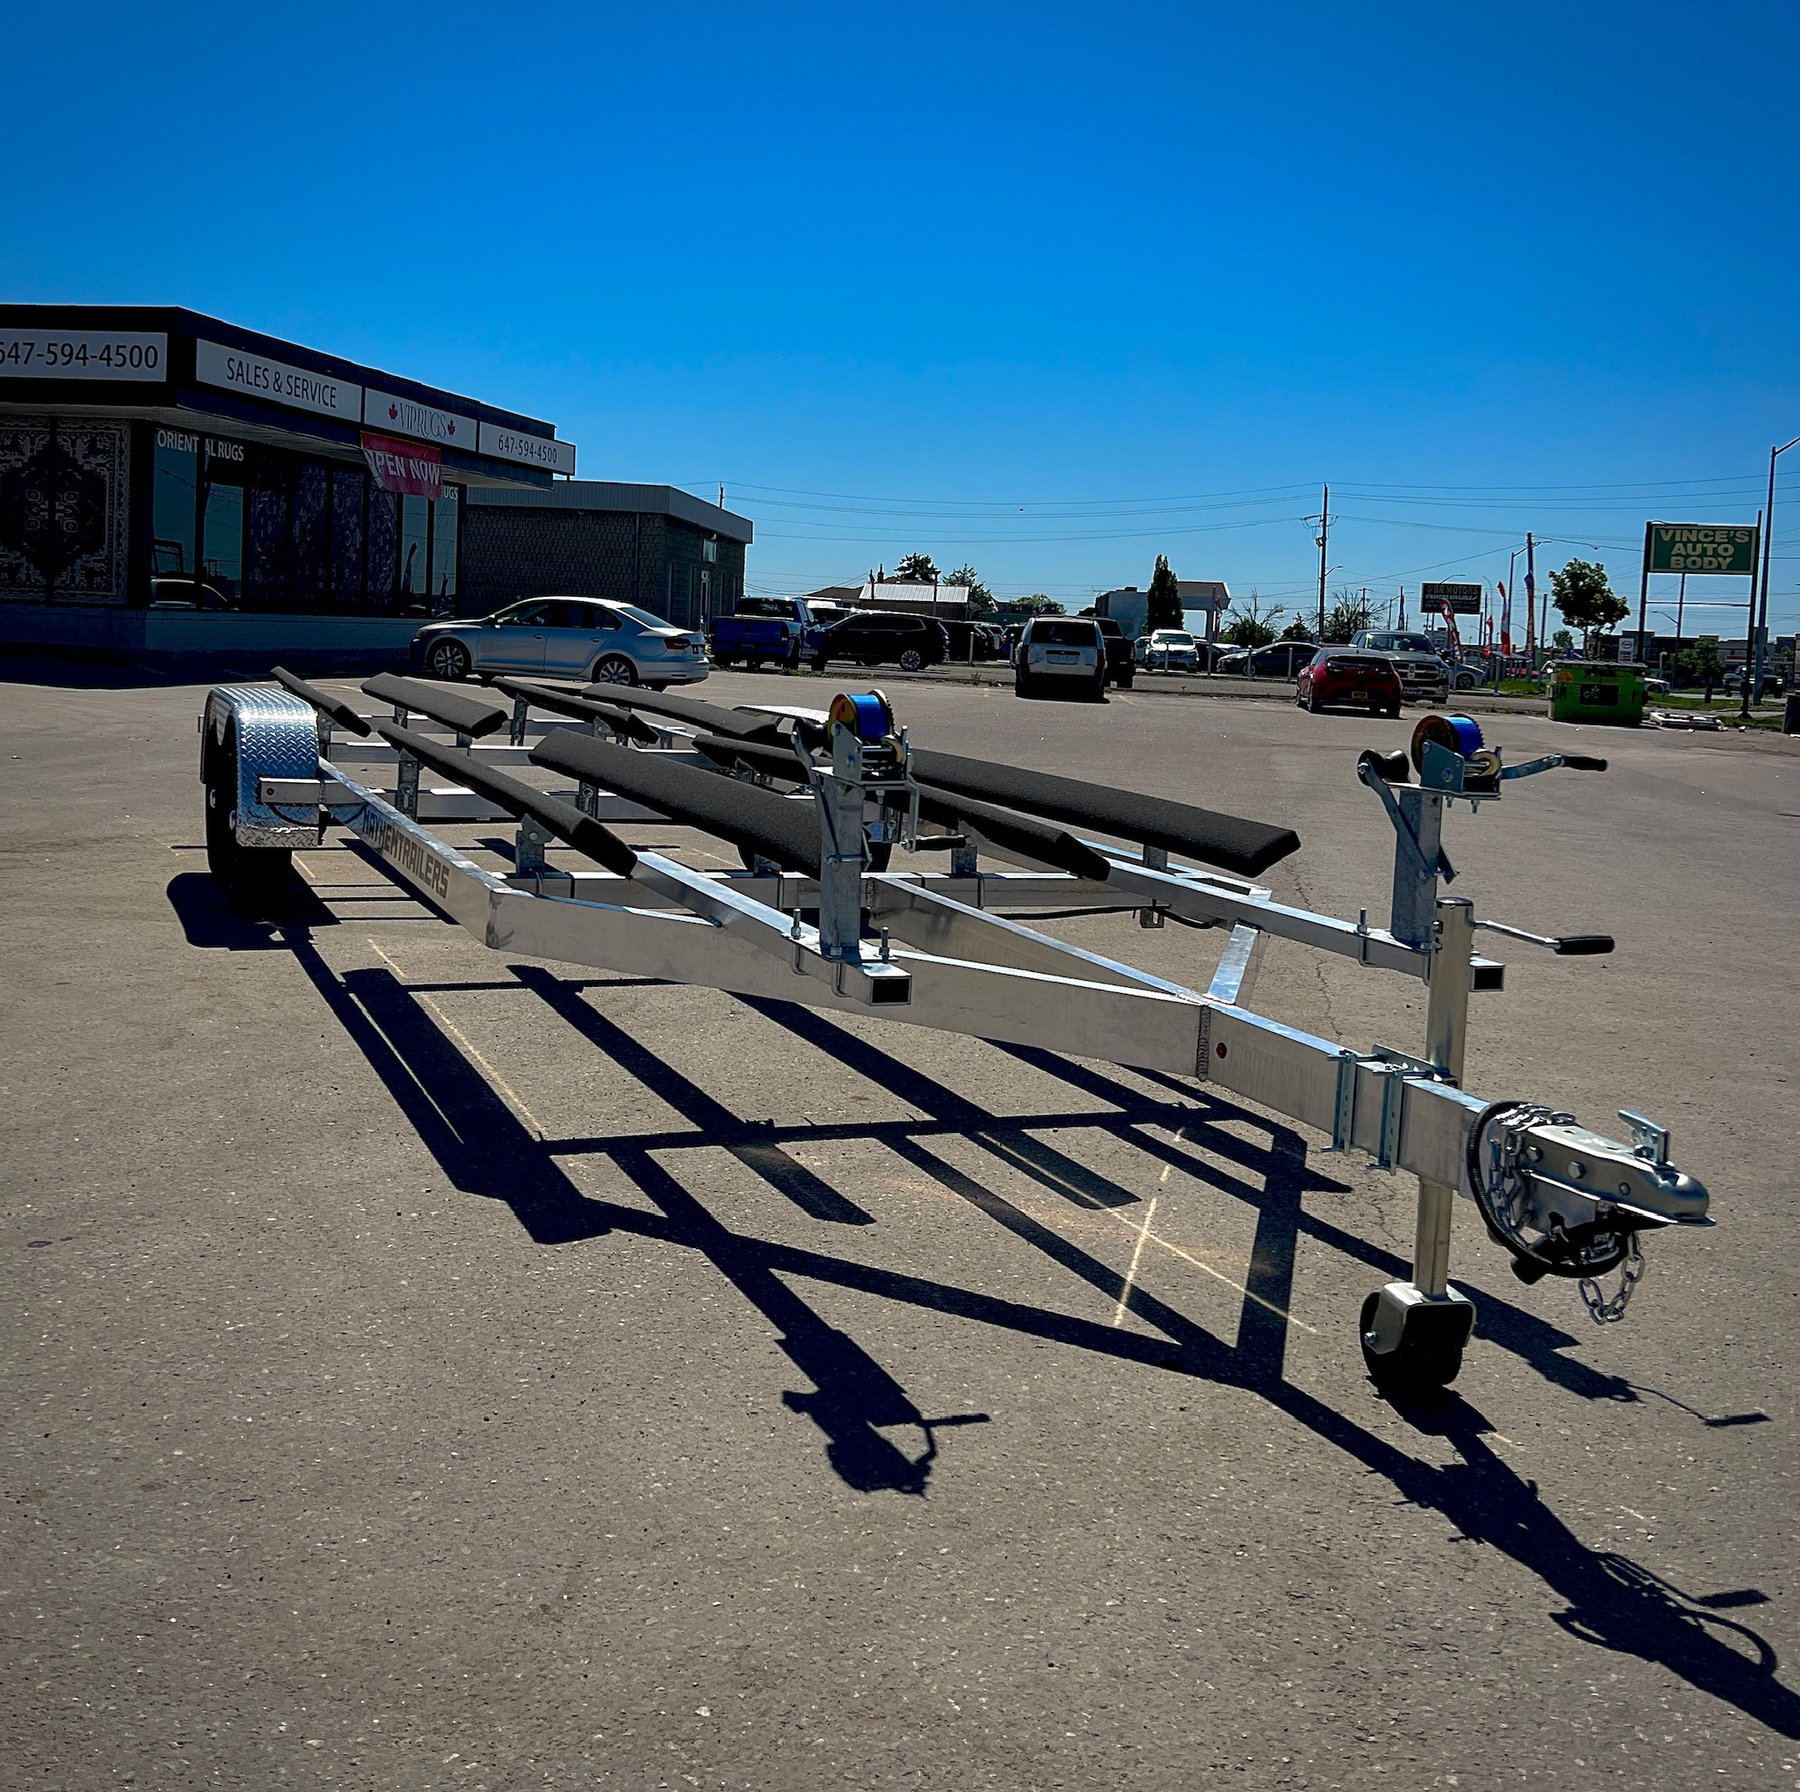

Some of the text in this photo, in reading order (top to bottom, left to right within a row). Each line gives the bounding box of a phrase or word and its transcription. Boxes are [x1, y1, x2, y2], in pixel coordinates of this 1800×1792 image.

[226, 357, 337, 409] SALES & SERVICE
[156, 430, 200, 454] ORIENT
[217, 440, 245, 462] RUGS
[498, 434, 558, 464] 647-594-4500
[408, 458, 440, 486] NOW
[442, 485, 459, 500] UGS
[1659, 529, 1750, 543] VINCE'S
[1670, 542, 1735, 557] AUTO
[1669, 556, 1733, 570] BODY
[1446, 585, 1478, 595] MOTORS
